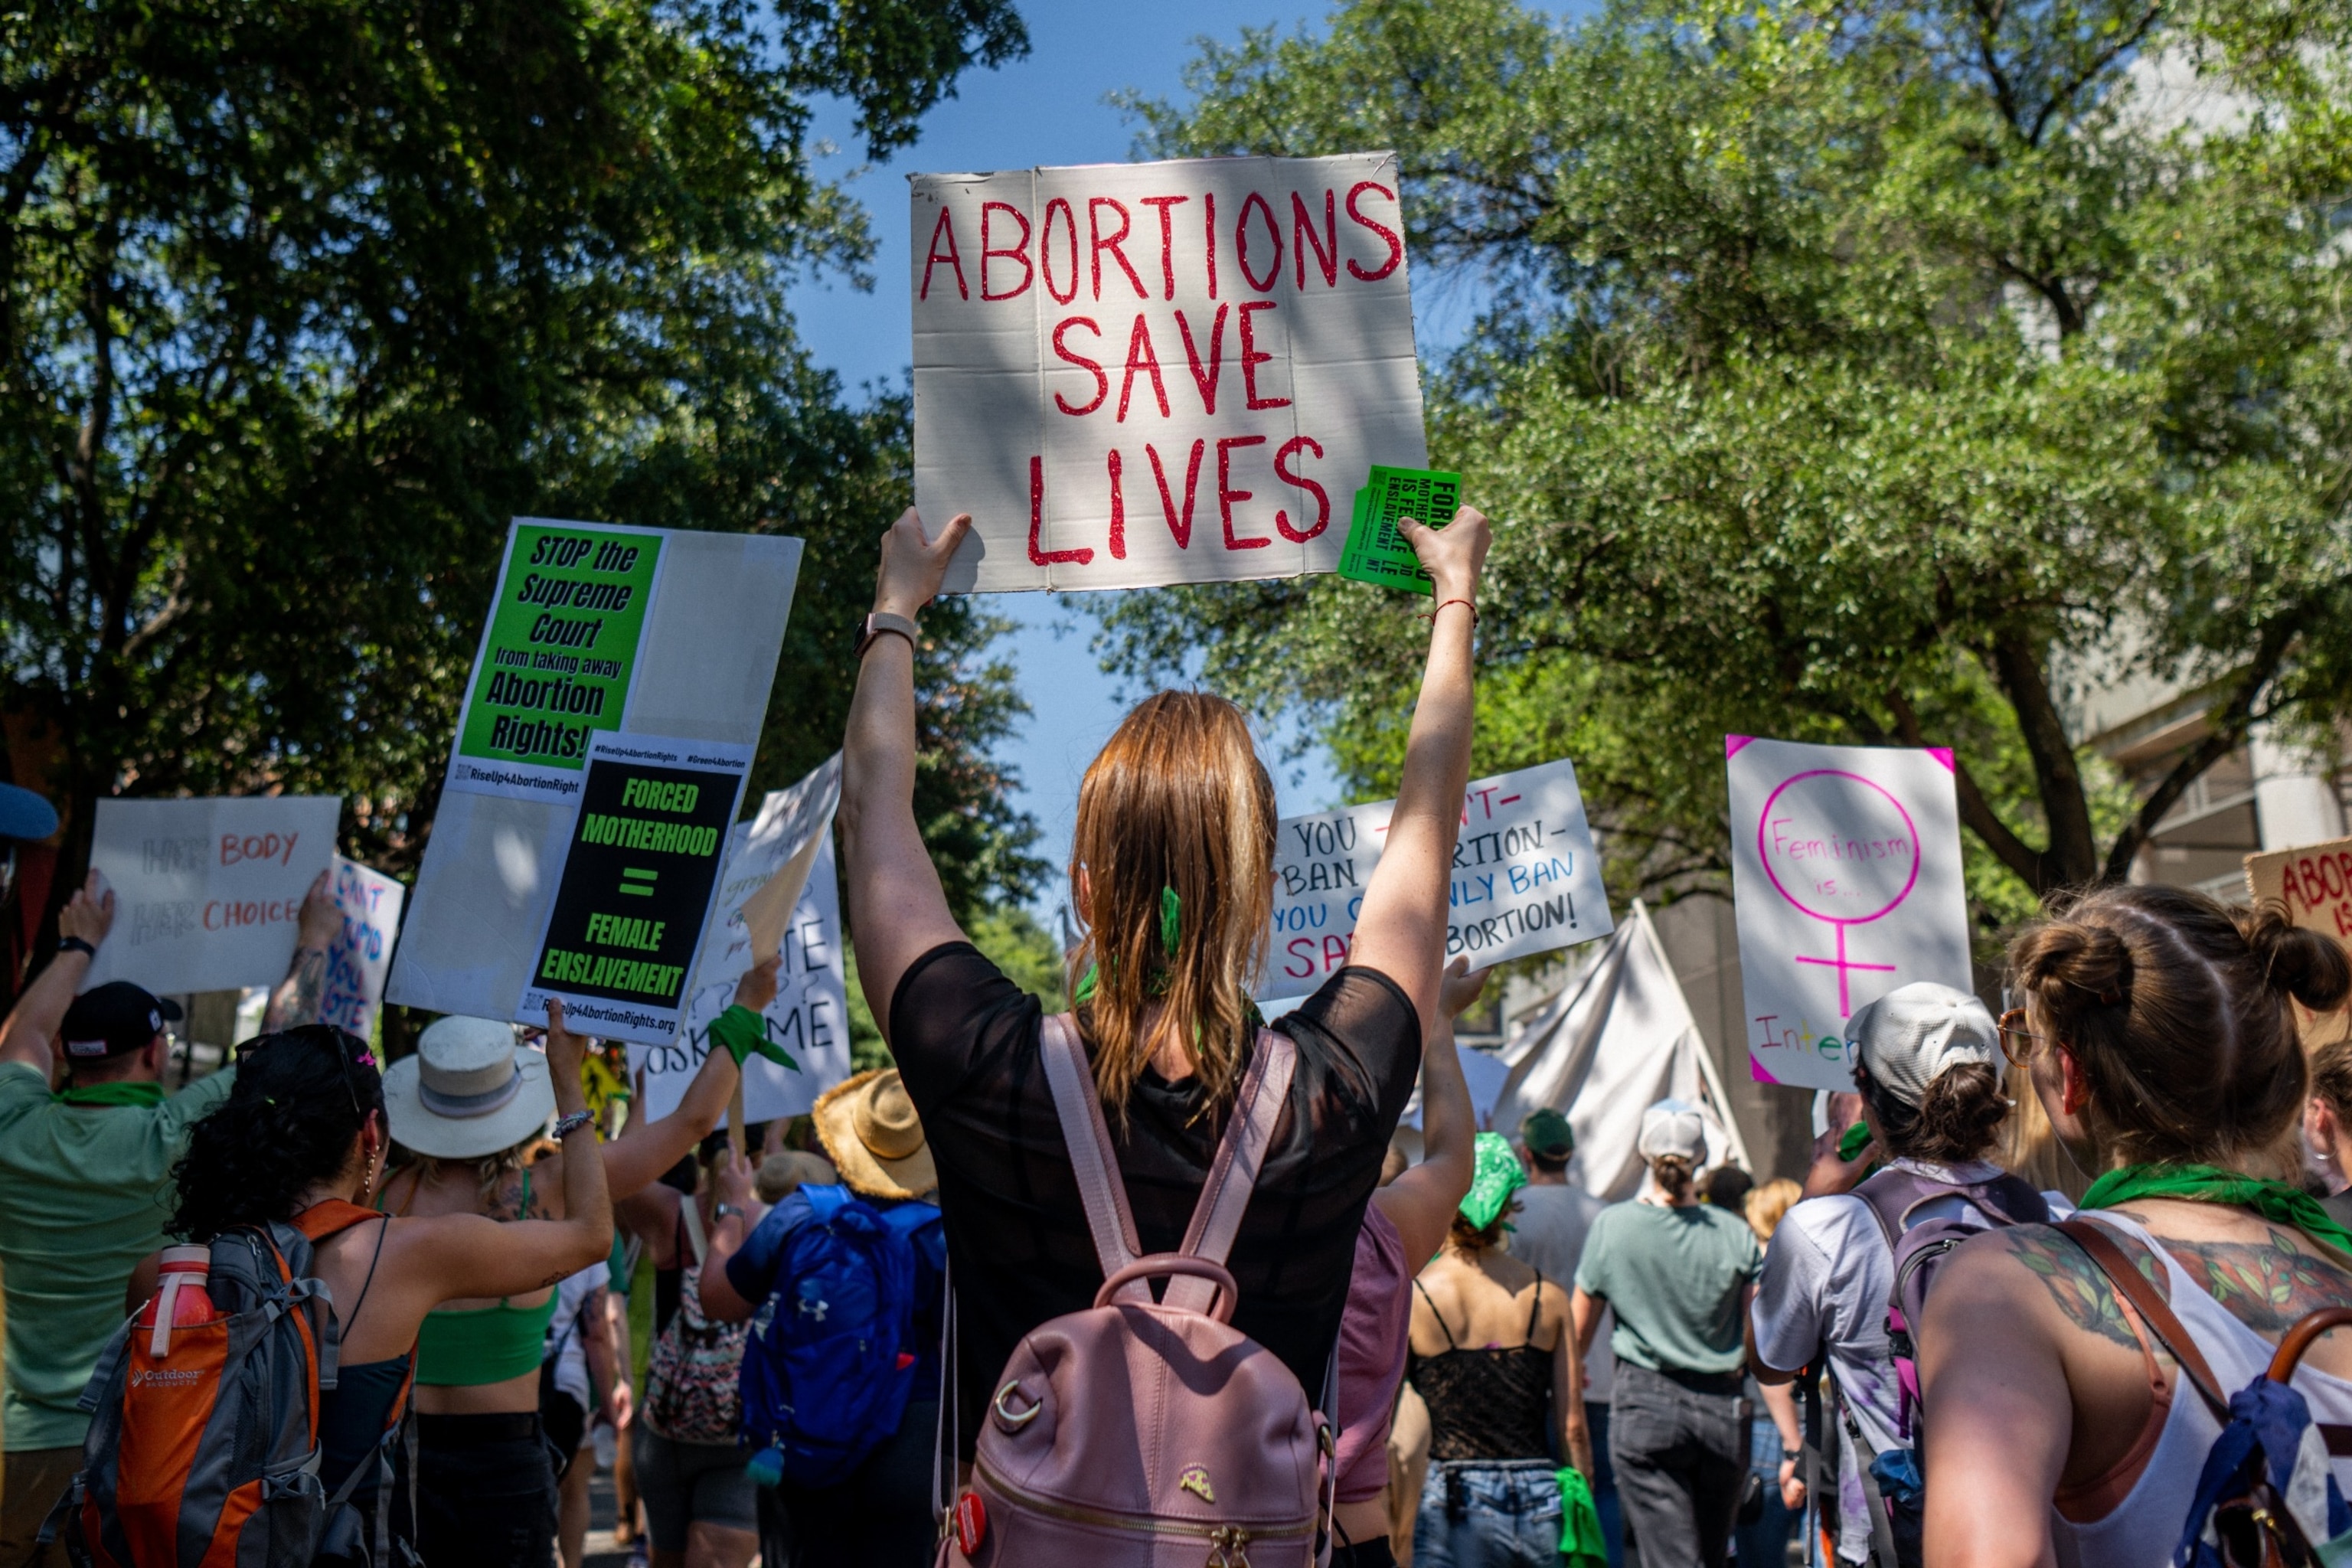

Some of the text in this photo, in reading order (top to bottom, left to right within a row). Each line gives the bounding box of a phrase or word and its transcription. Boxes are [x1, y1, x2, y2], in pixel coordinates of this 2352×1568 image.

[920, 181, 1402, 305] ABORTIONS
[1054, 302, 1292, 423] SAVE
[1028, 436, 1331, 566] LIVES
[1402, 479, 1418, 494] IS
[1376, 476, 1401, 551] ENSLAVEMENT
[531, 536, 639, 573] STOP the
[518, 573, 633, 612] Supreme
[529, 613, 603, 649] Court
[495, 646, 622, 681] from taking away
[485, 671, 605, 717] Abortion
[490, 715, 591, 760] Rights!
[594, 743, 746, 769] #RiseUp4AbortionRights #Green4Abortion
[622, 778, 699, 813] FORCED
[220, 831, 299, 867] BODY
[581, 813, 718, 858] MOTHERHOOD
[1293, 816, 1357, 858] YOU
[1772, 817, 1910, 861] Feminism
[1282, 858, 1358, 897] BAN
[1508, 851, 1573, 895] BAN
[1814, 879, 1861, 897] is...
[203, 898, 299, 932] CHOICE
[586, 913, 665, 952] FEMALE
[1272, 902, 1327, 933] YOU
[1446, 892, 1578, 956] BORTION!
[541, 948, 684, 997] ENSLAVEMENT
[1283, 932, 1354, 978] SA
[541, 996, 676, 1034] ReUp4AbortionRights.org
[766, 1001, 834, 1050] ME
[144, 1369, 199, 1381] Outdoor
